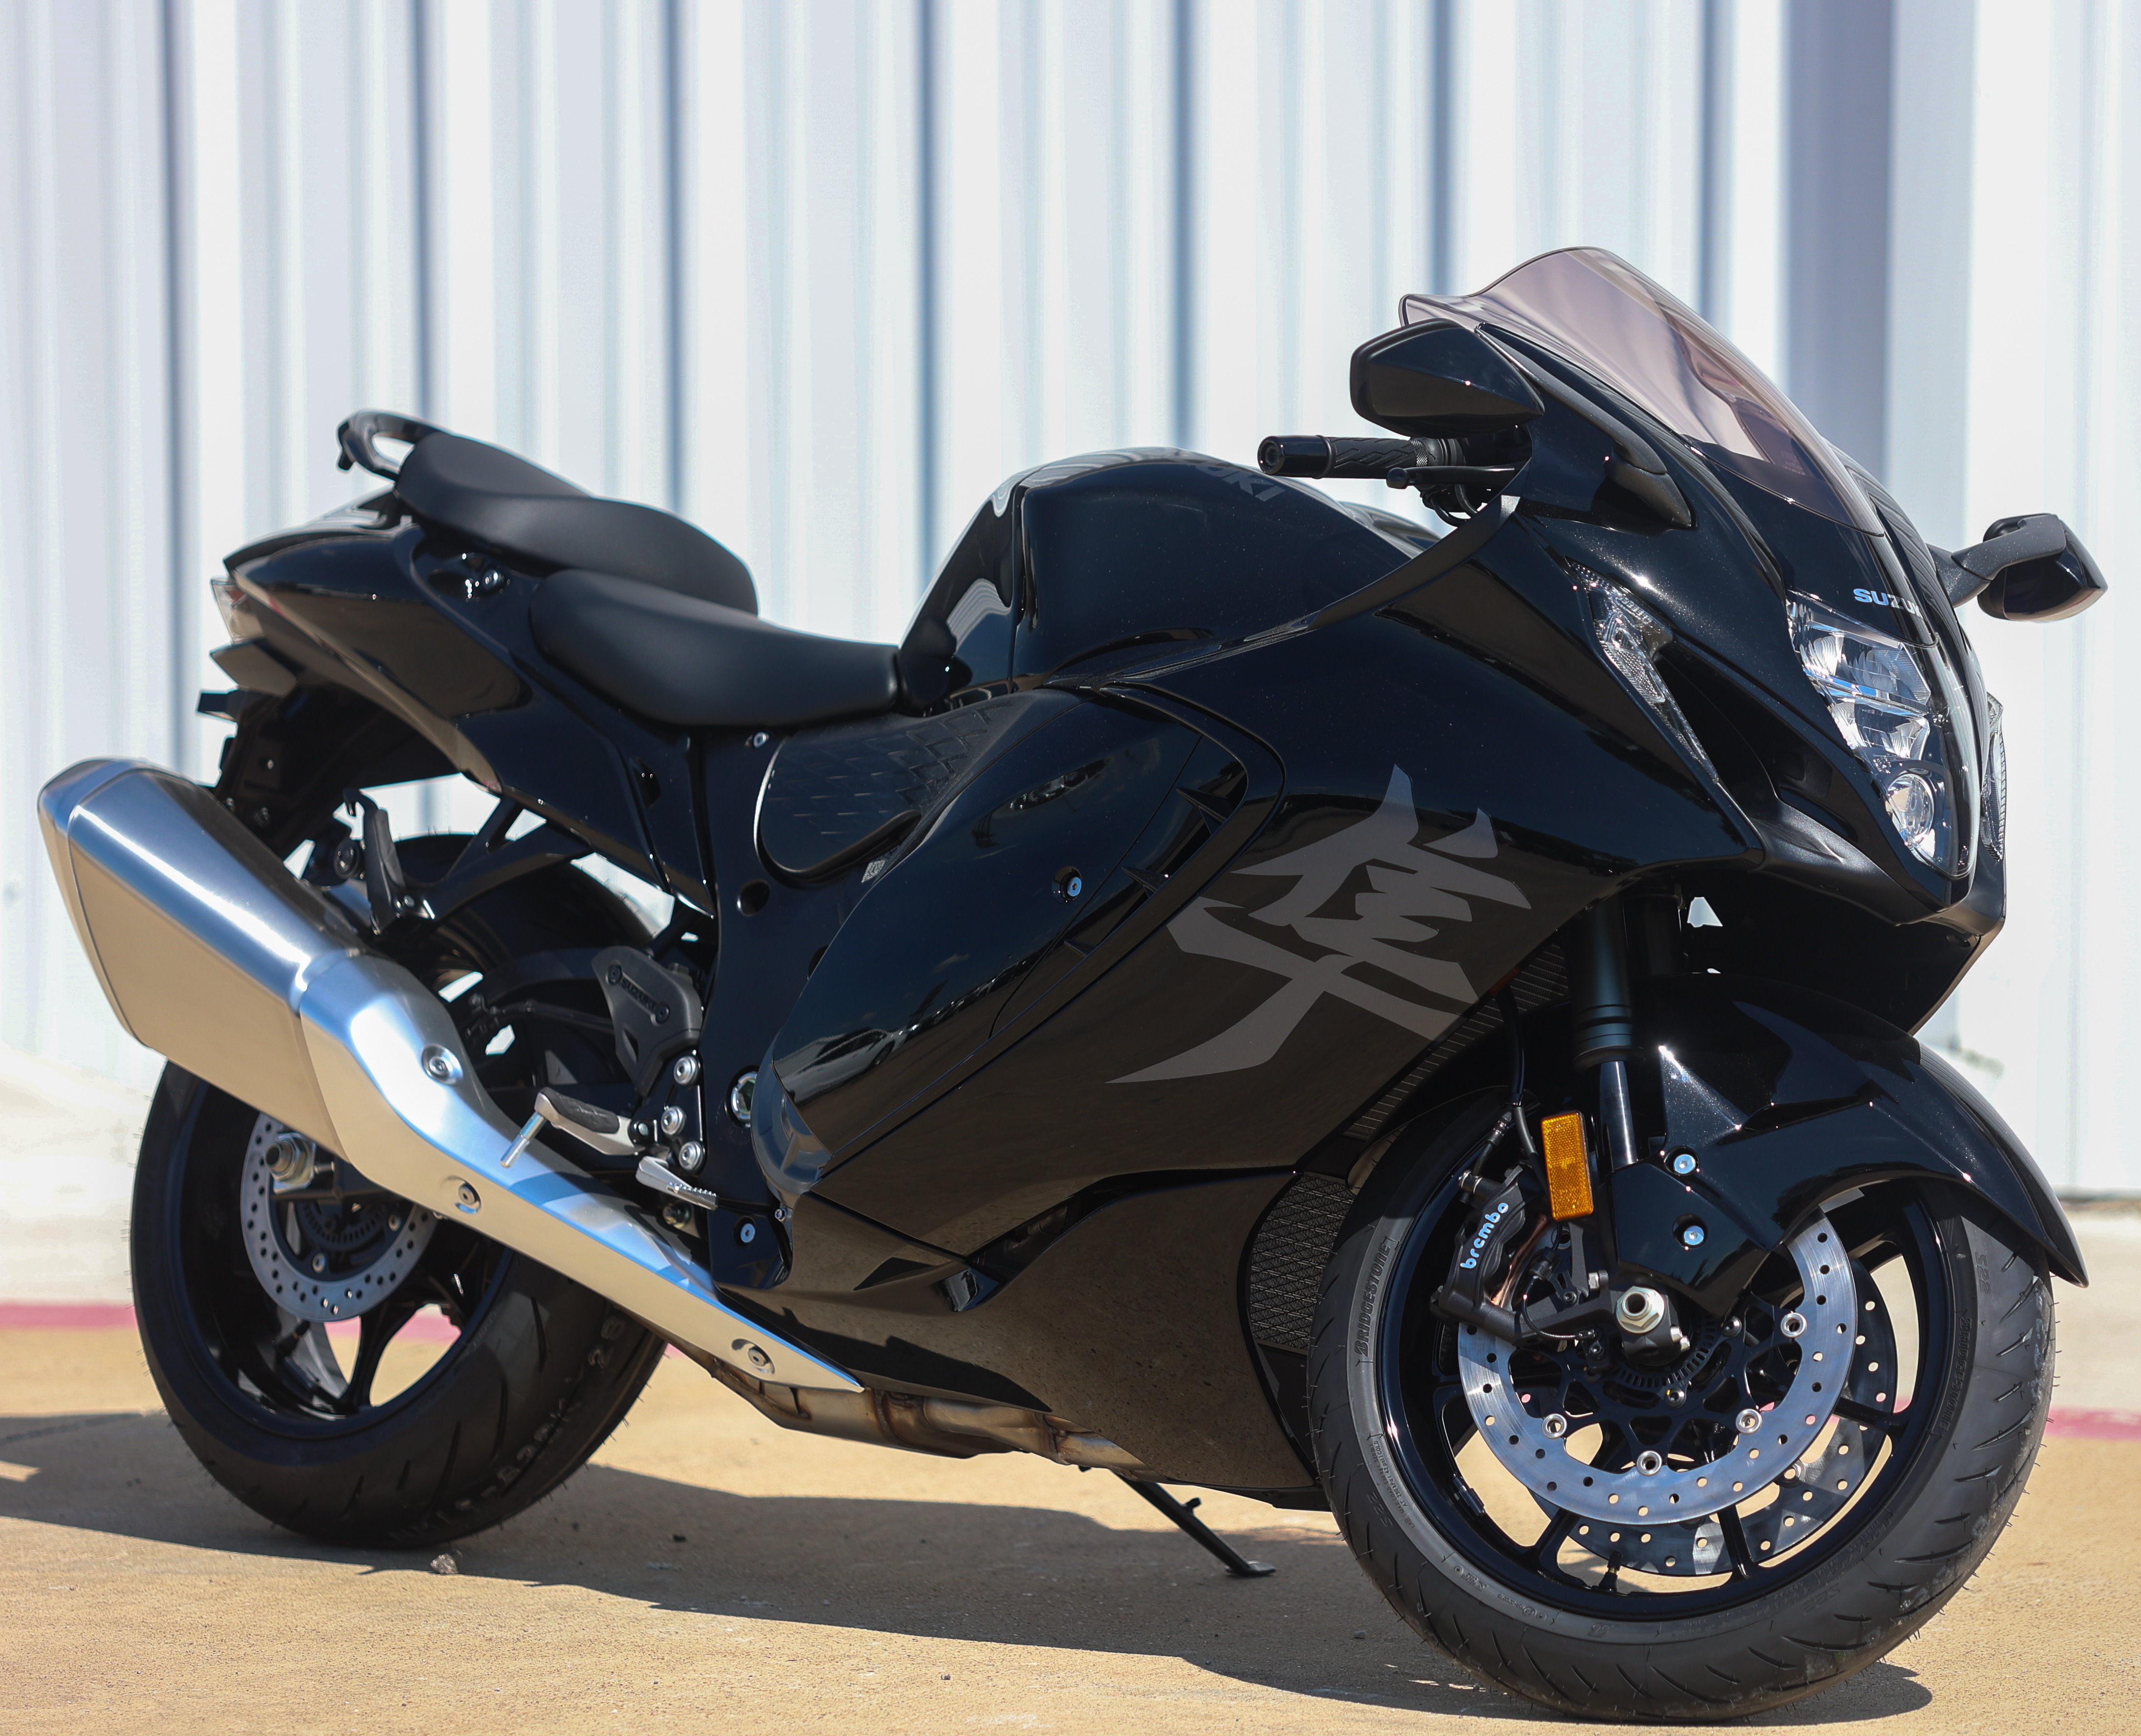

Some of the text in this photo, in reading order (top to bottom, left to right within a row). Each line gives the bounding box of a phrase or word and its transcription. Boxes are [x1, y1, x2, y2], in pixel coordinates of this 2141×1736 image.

[1853, 588, 1923, 619] SUZUK
[621, 978, 656, 1010] SUZUKI
[1460, 1203, 1508, 1269] brembo
[1354, 1241, 1391, 1358] BRIDGESTONE
[1974, 1251, 1992, 1295] S22
[1939, 1317, 1972, 1432] BRIDGESTONE
